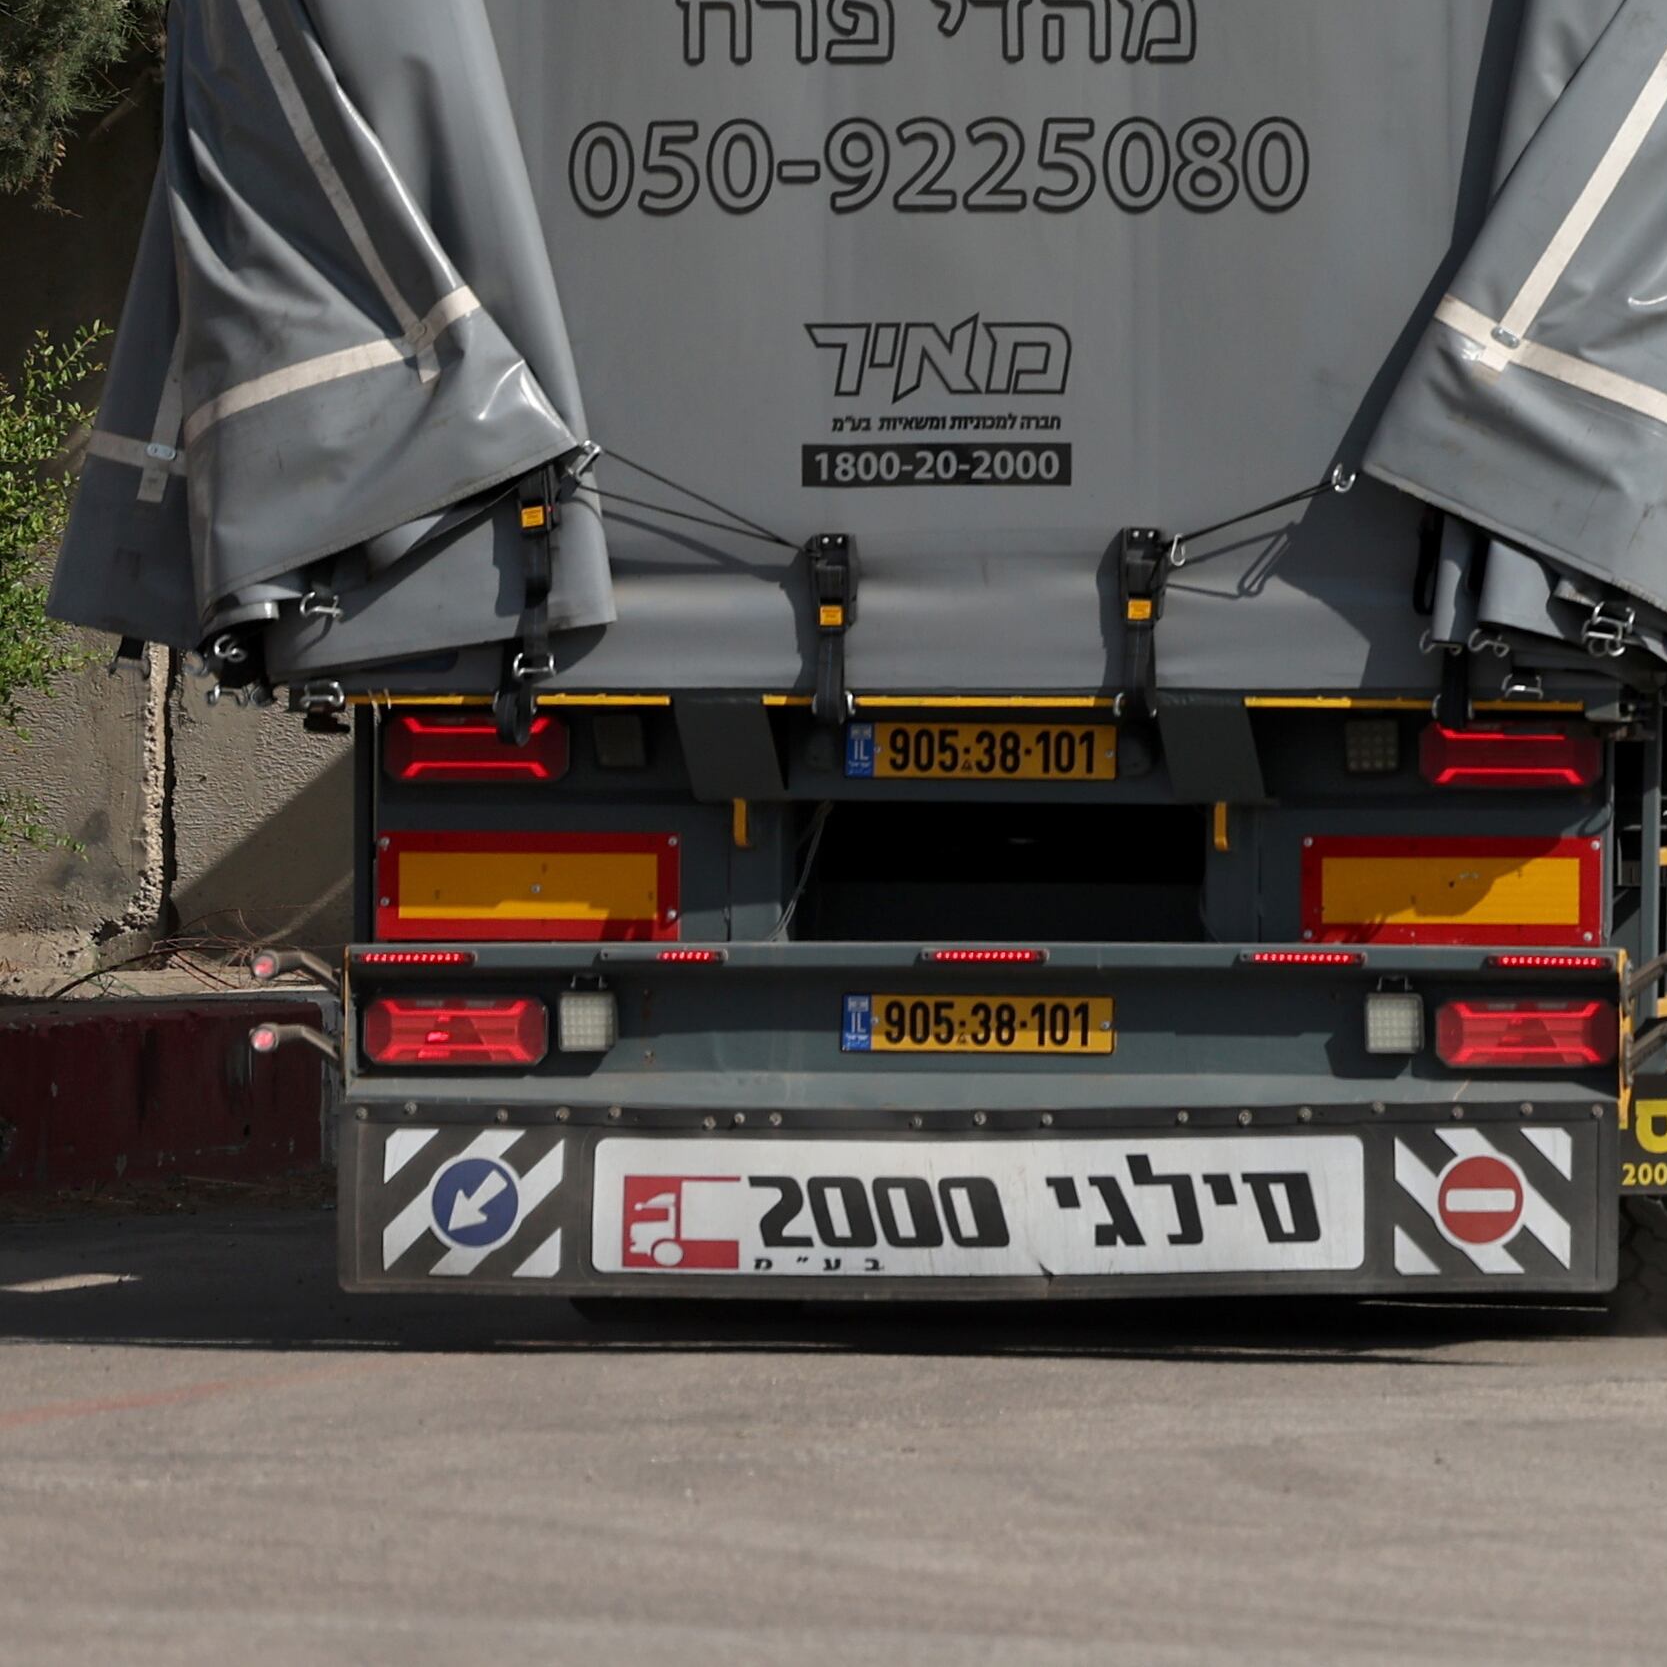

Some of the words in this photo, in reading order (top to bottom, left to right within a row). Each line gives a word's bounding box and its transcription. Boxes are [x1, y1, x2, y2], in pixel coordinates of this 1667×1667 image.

[567, 116, 1311, 219] 050-9225080
[803, 310, 1073, 406] מאיר
[877, 414, 945, 432] ומשאיות
[949, 412, 1017, 431] למכוניות
[1019, 413, 1062, 431] חברה
[813, 449, 1060, 482] 1800-20-2000
[853, 739, 869, 762] IL
[851, 1012, 867, 1034] IL
[747, 1175, 1011, 1249] 2000
[1045, 1153, 1322, 1248] סילגי
